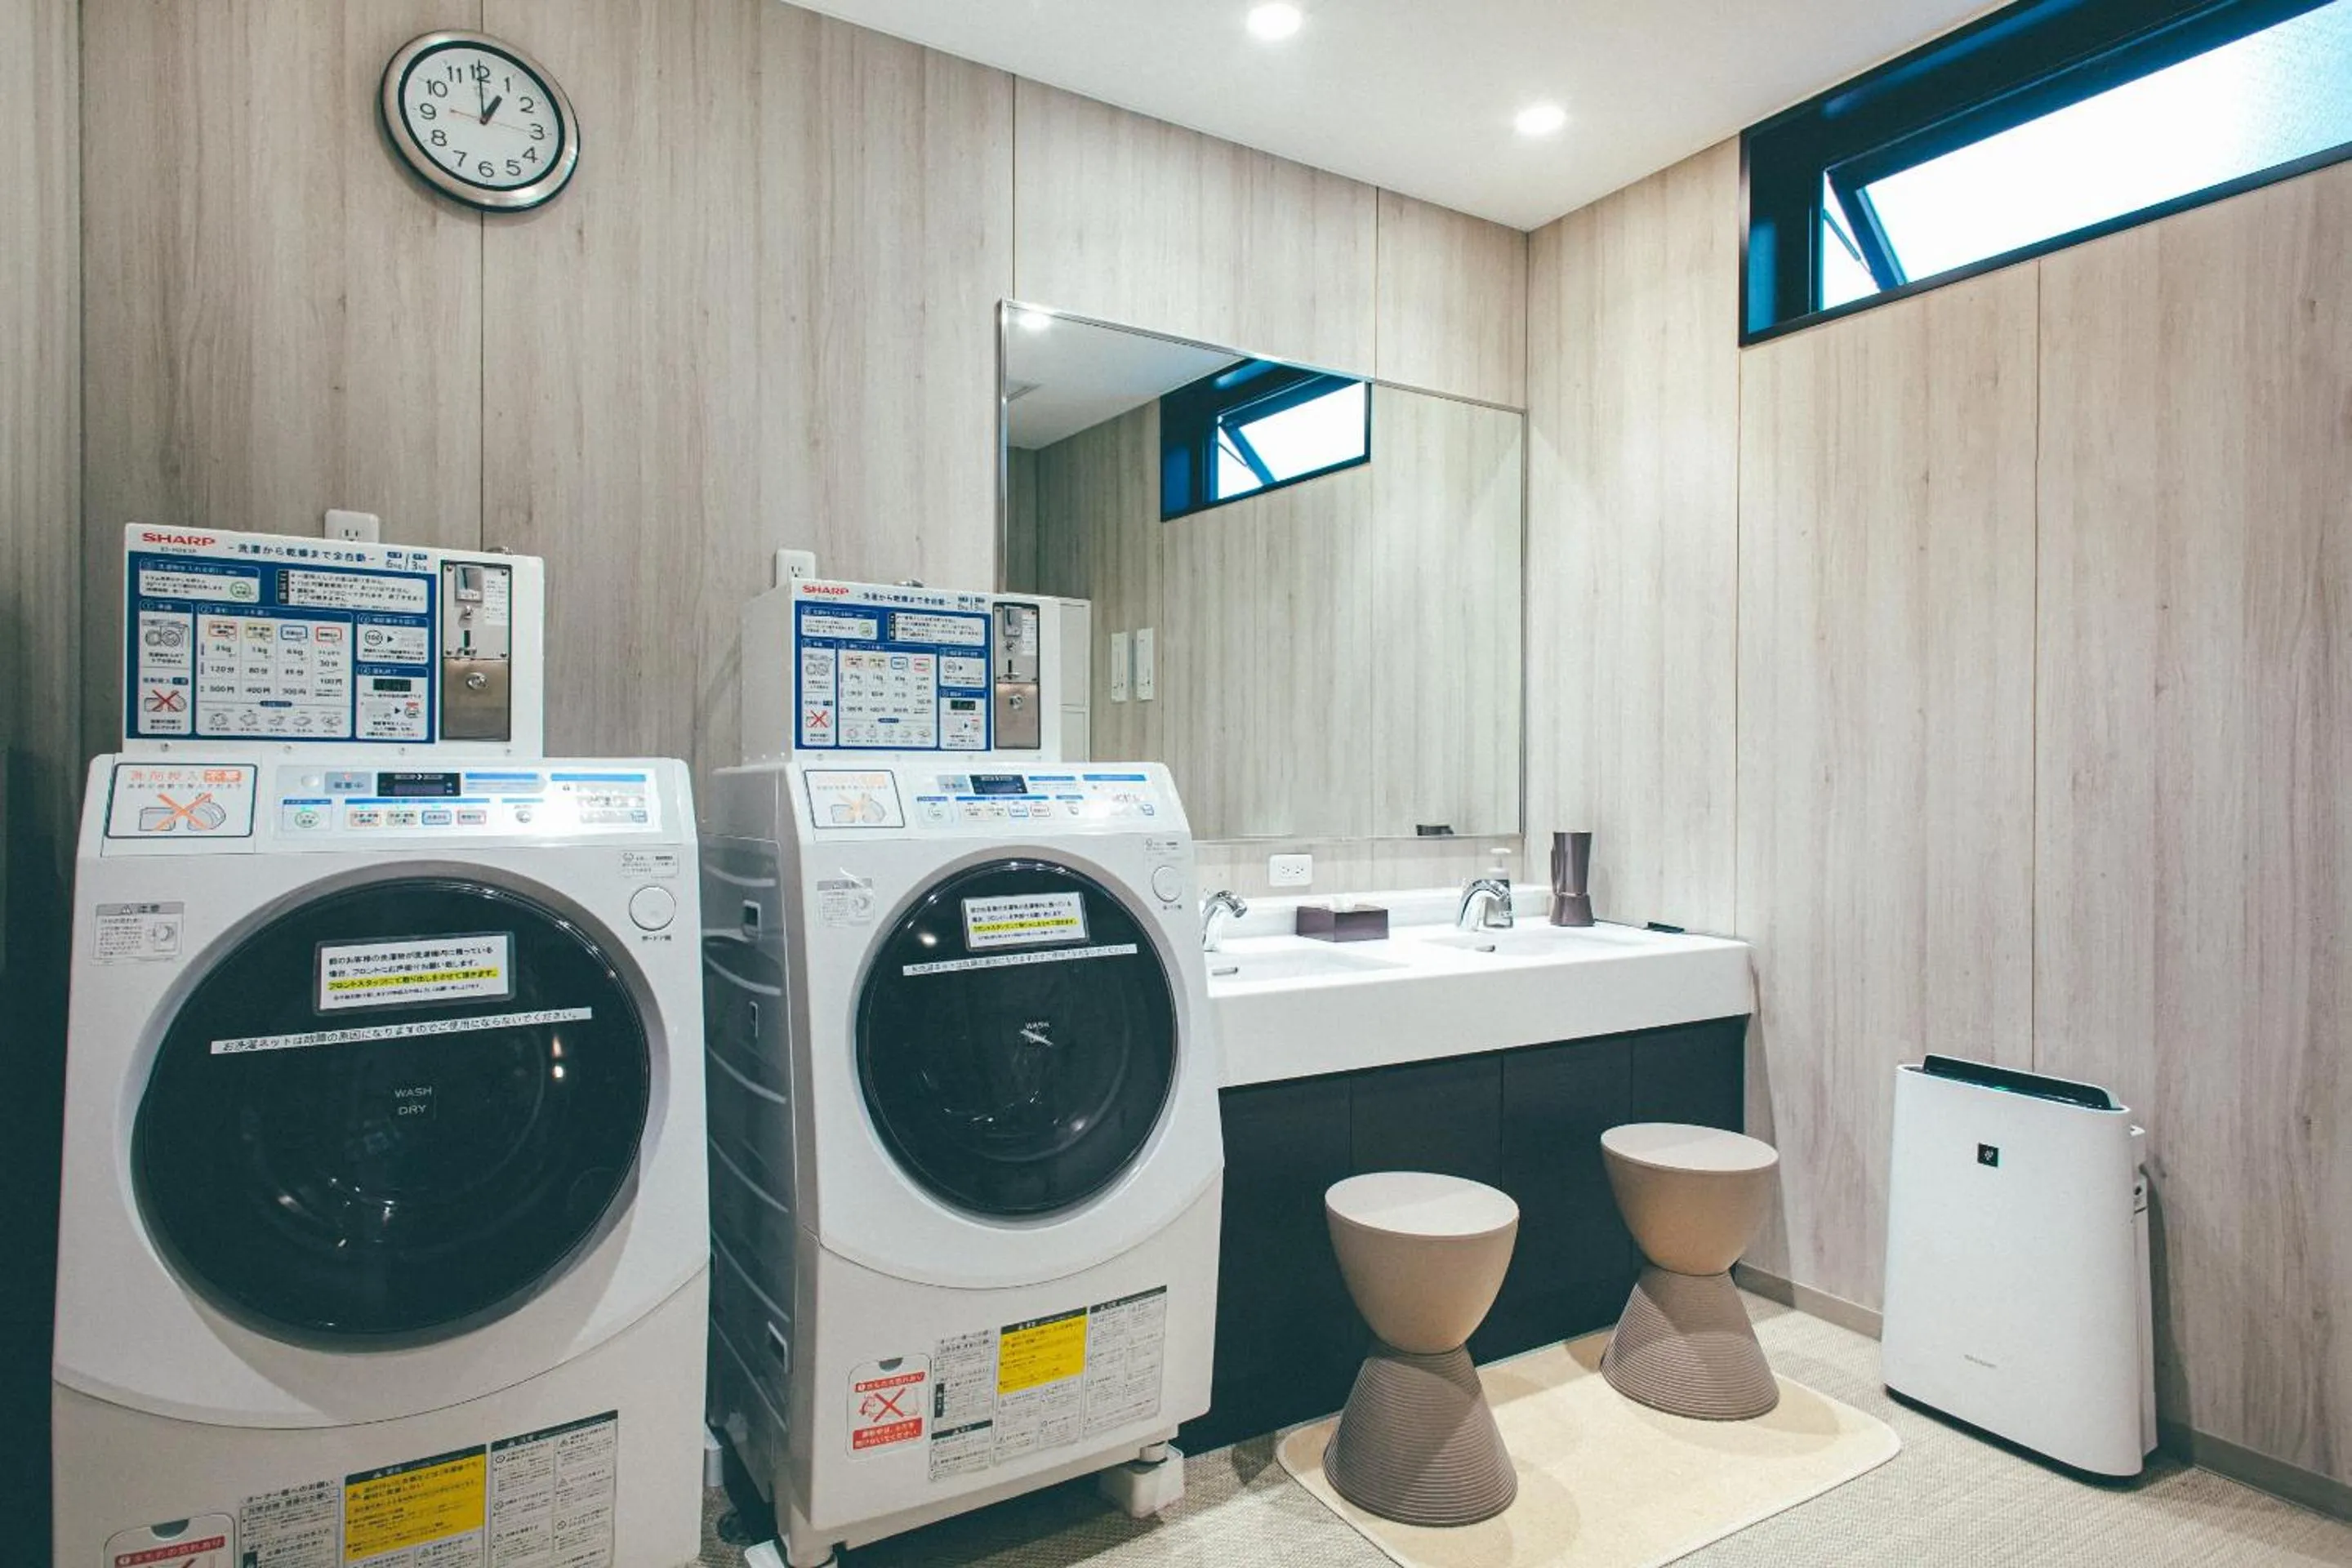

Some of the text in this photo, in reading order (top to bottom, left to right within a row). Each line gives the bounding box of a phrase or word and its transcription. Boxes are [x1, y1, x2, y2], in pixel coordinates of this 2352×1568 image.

[447, 65, 462, 83] 11
[469, 63, 491, 83] 12
[426, 79, 448, 98] 10
[504, 77, 511, 93] 1
[420, 103, 437, 120] 9
[519, 96, 534, 114] 2
[430, 130, 448, 146] 8
[530, 124, 545, 140] 3
[453, 150, 467, 167] 7
[522, 147, 538, 163] 4
[478, 162, 495, 177] 6
[506, 159, 522, 176] 5
[142, 532, 216, 546] SHARP
[802, 584, 849, 595] SHARP
[394, 1086, 432, 1098] WASH
[399, 1105, 426, 1116] DRY
